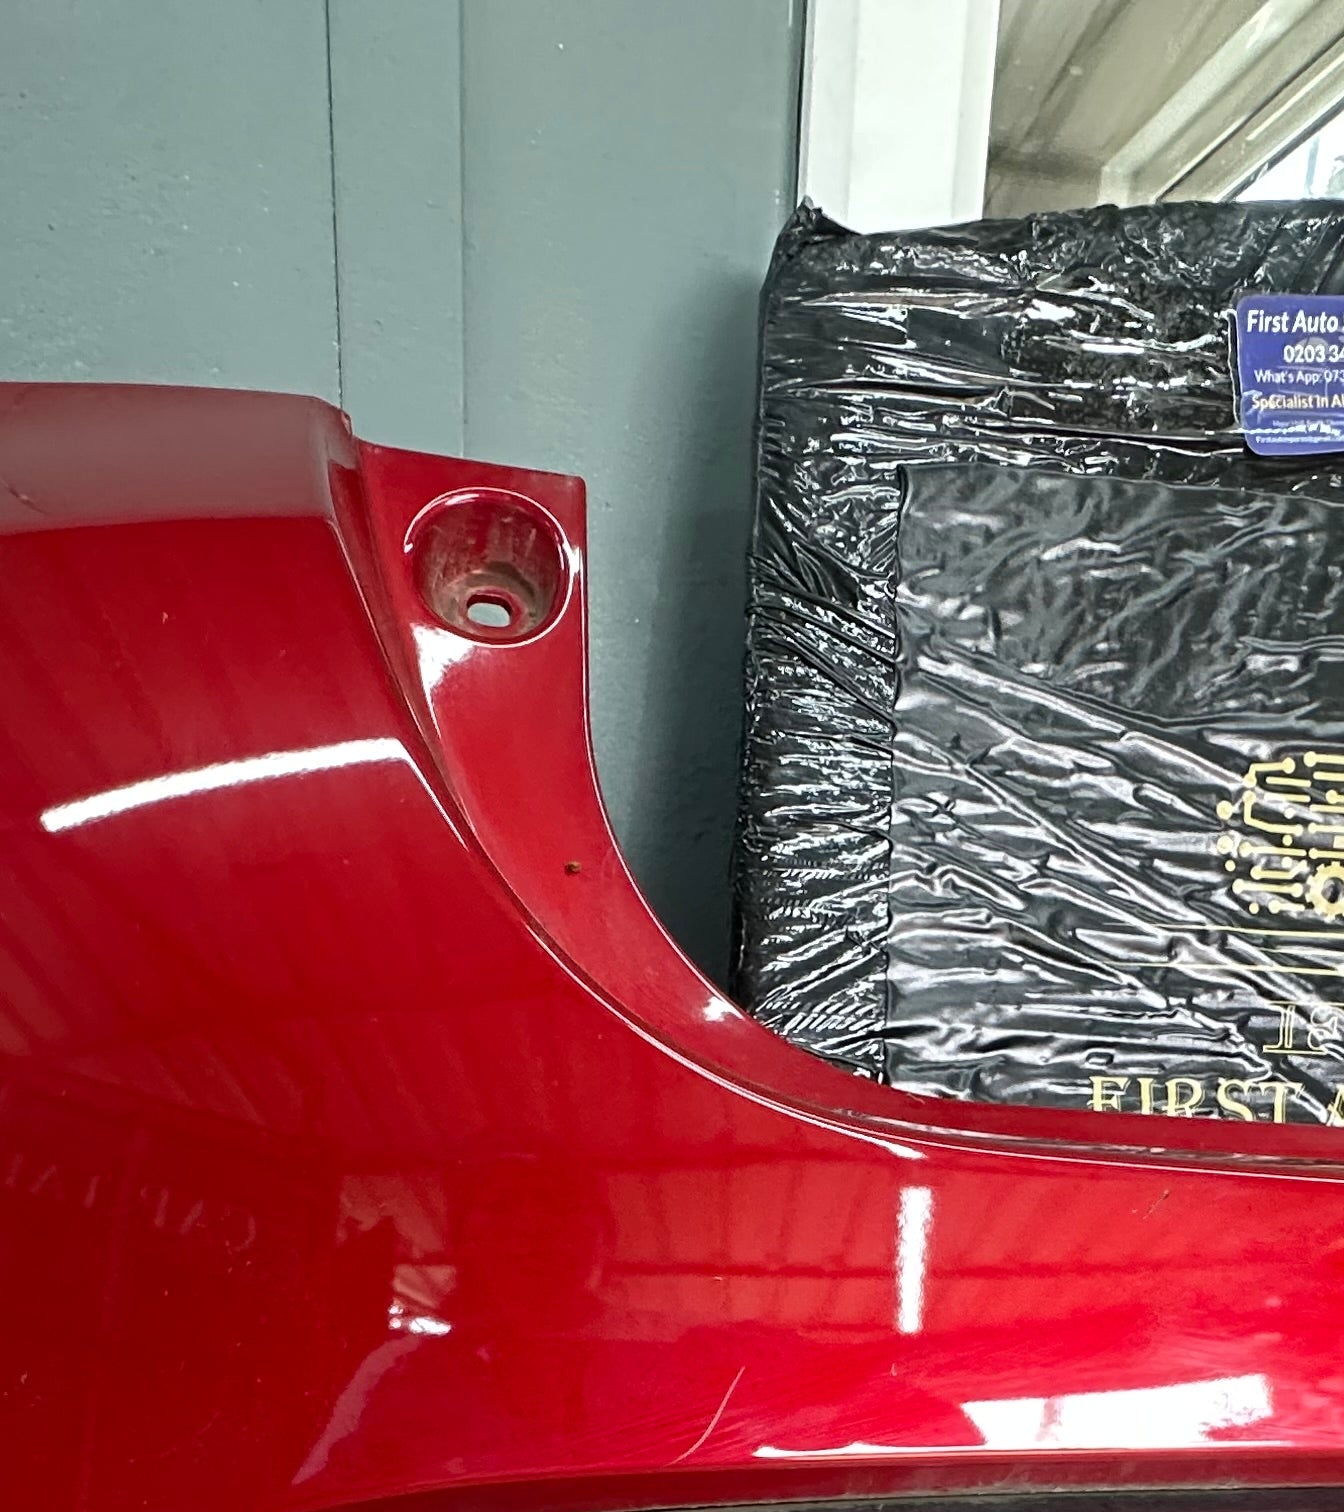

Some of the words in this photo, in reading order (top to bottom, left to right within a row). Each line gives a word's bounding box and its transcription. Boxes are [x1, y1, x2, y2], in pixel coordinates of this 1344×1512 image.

[1246, 310, 1289, 333] First
[1292, 310, 1338, 333] Auto
[1283, 344, 1326, 363] 0203
[1254, 369, 1294, 383] What's
[1251, 393, 1314, 410] Specialist
[1088, 1075, 1305, 1124] FIRST
